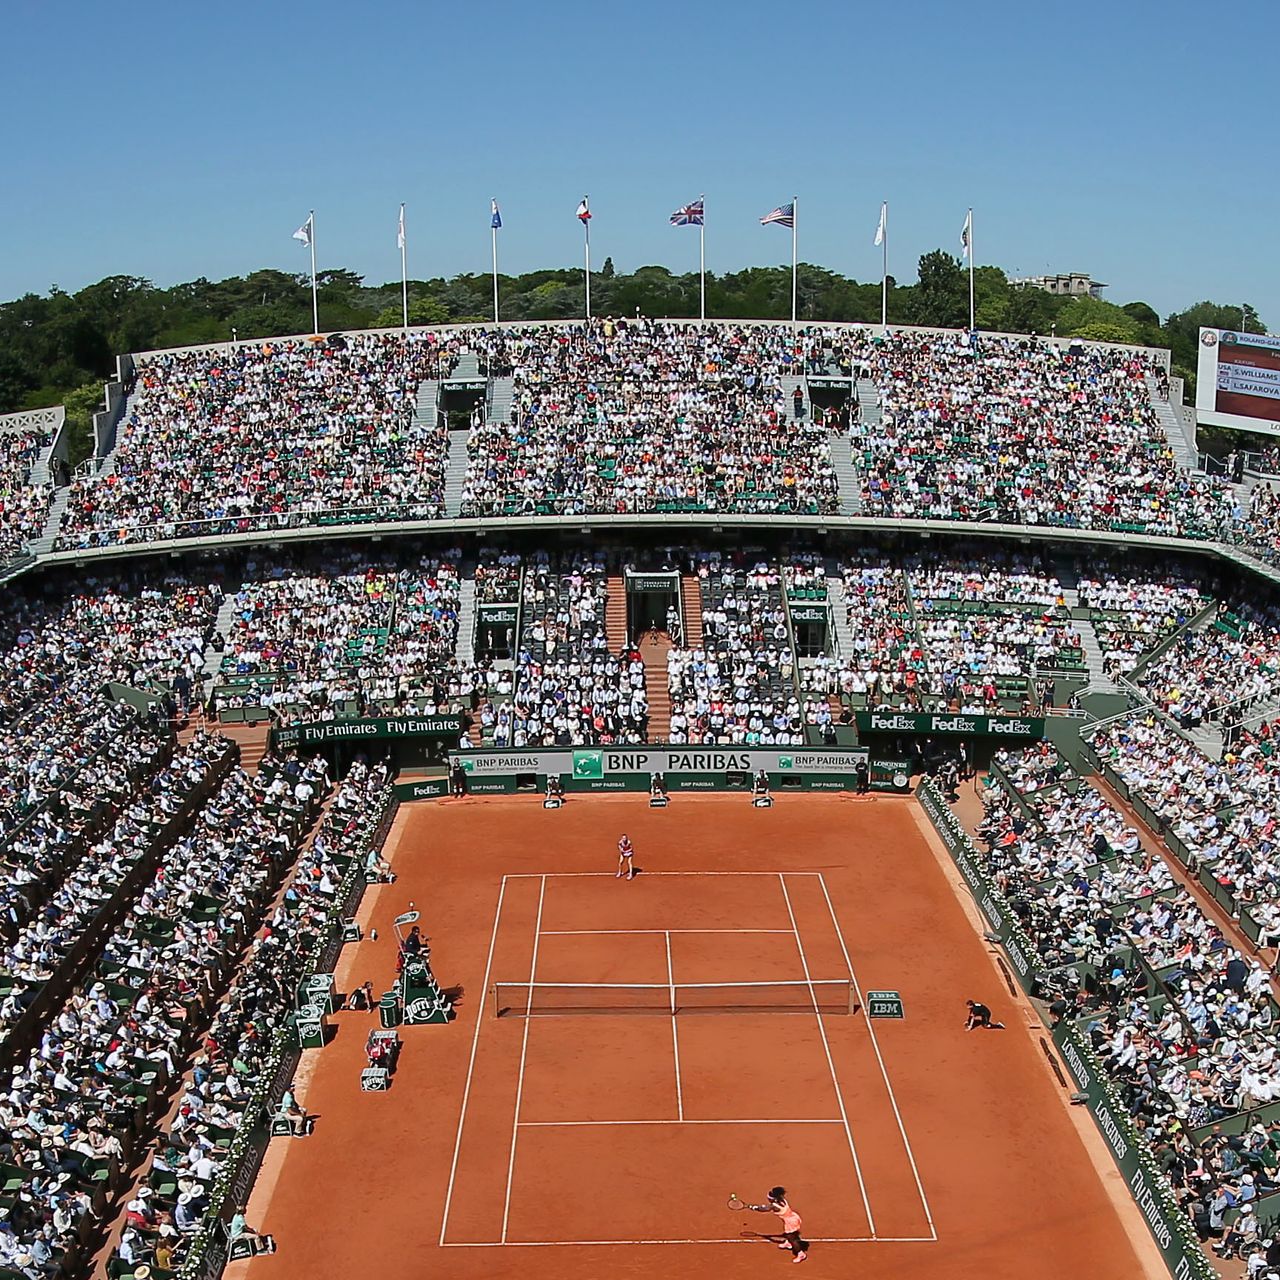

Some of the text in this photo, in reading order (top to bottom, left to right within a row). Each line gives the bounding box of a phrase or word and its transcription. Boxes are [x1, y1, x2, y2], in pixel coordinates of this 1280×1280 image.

[1234, 368, 1278, 381] S.WILLIAMS
[1233, 382, 1280, 395] L.SAFAROVA
[482, 611, 516, 623] FedEx
[791, 609, 823, 620] FedEx
[387, 718, 460, 736] Fly Emirates
[872, 715, 916, 730] FedEx
[932, 717, 975, 732] FedEx
[988, 719, 1031, 734] FedEx
[305, 723, 377, 740] Fly Emirates
[476, 758, 539, 767] BNP PARIBAS
[608, 753, 751, 770] BNP PARIBAS
[795, 756, 857, 765] BNP PARIBAS
[414, 786, 440, 796] FedEx
[981, 893, 1002, 930] LONGINES
[1006, 935, 1029, 977] LONGINES
[874, 1003, 898, 1013] IBM
[1061, 1036, 1090, 1089] LONGINES
[1095, 1099, 1128, 1160] LONGINES
[231, 1145, 258, 1206] LONGINES
[1130, 1168, 1172, 1250] Fly Emirates
